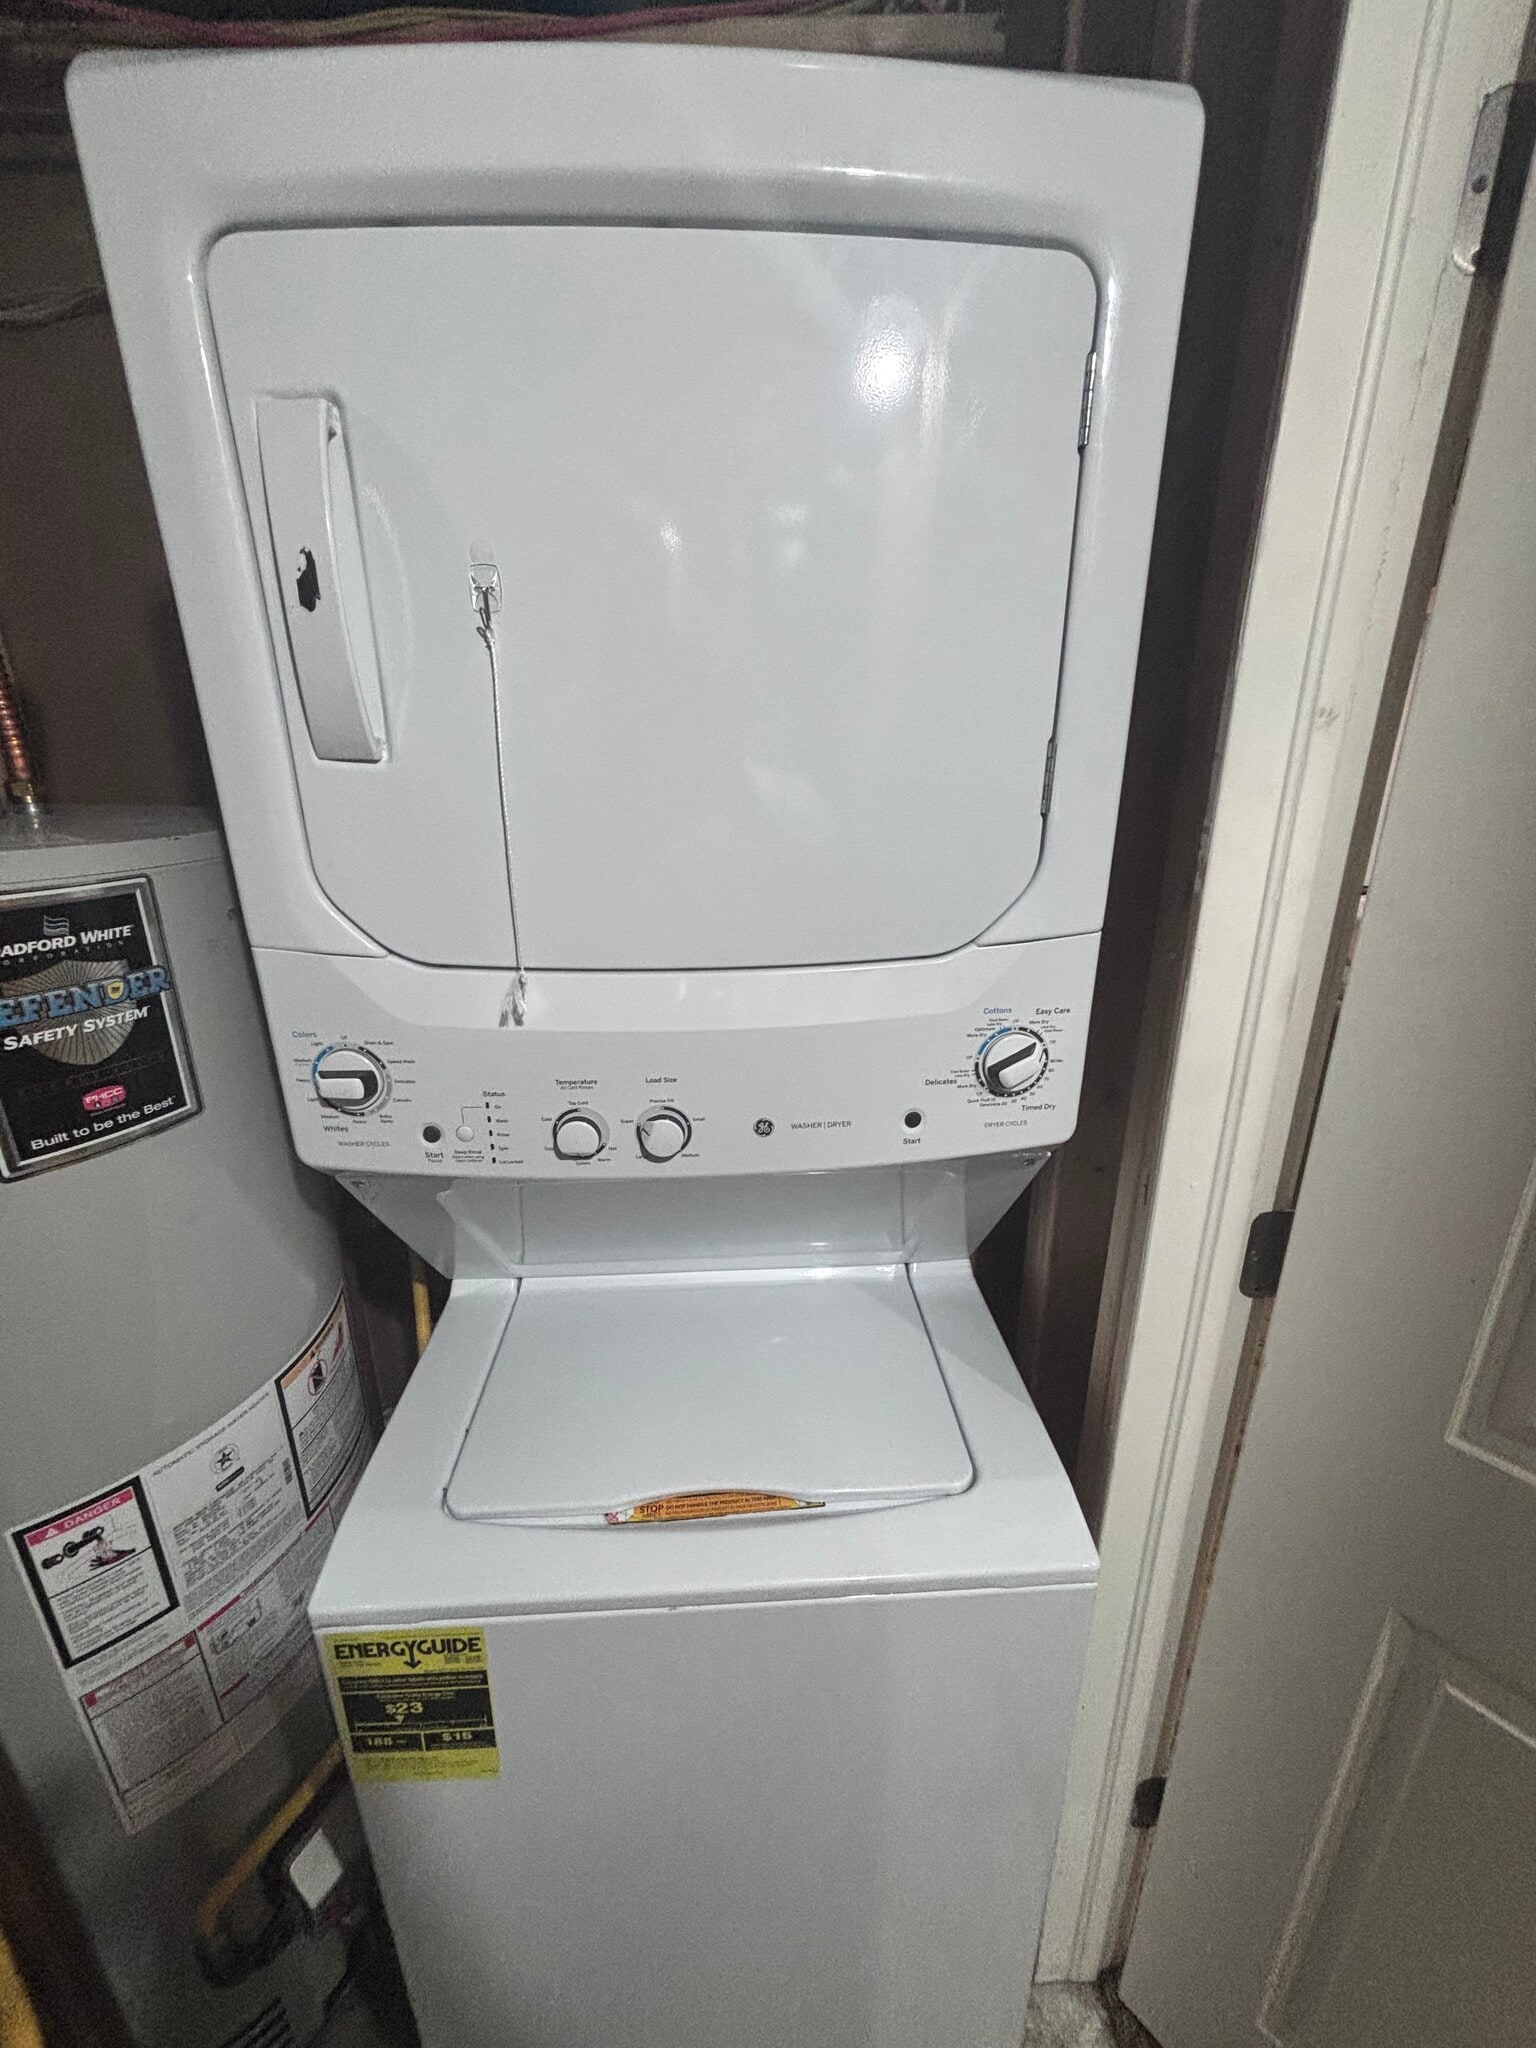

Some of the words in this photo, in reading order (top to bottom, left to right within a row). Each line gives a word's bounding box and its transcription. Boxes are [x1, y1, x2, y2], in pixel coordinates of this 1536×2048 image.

[80, 925, 132, 945] WHITE
[1035, 1008, 1053, 1016] Easy
[1054, 1007, 1071, 1015] Care
[4, 1024, 78, 1051] SAFETY
[83, 1007, 148, 1033] SYSTEM
[85, 1086, 125, 1104] PHCC
[1044, 1103, 1056, 1111] Dry
[31, 1131, 70, 1150] Built
[72, 1125, 90, 1138] to
[93, 1119, 114, 1132] be
[116, 1110, 141, 1124] the
[143, 1097, 174, 1115] Best
[790, 1121, 822, 1130] WASHER
[827, 1120, 852, 1128] DRYER
[63, 1497, 122, 1529] DANGER
[639, 1504, 664, 1514] STOP
[334, 1637, 483, 1664] ENERGYGUIDE
[384, 1701, 424, 1715] $23
